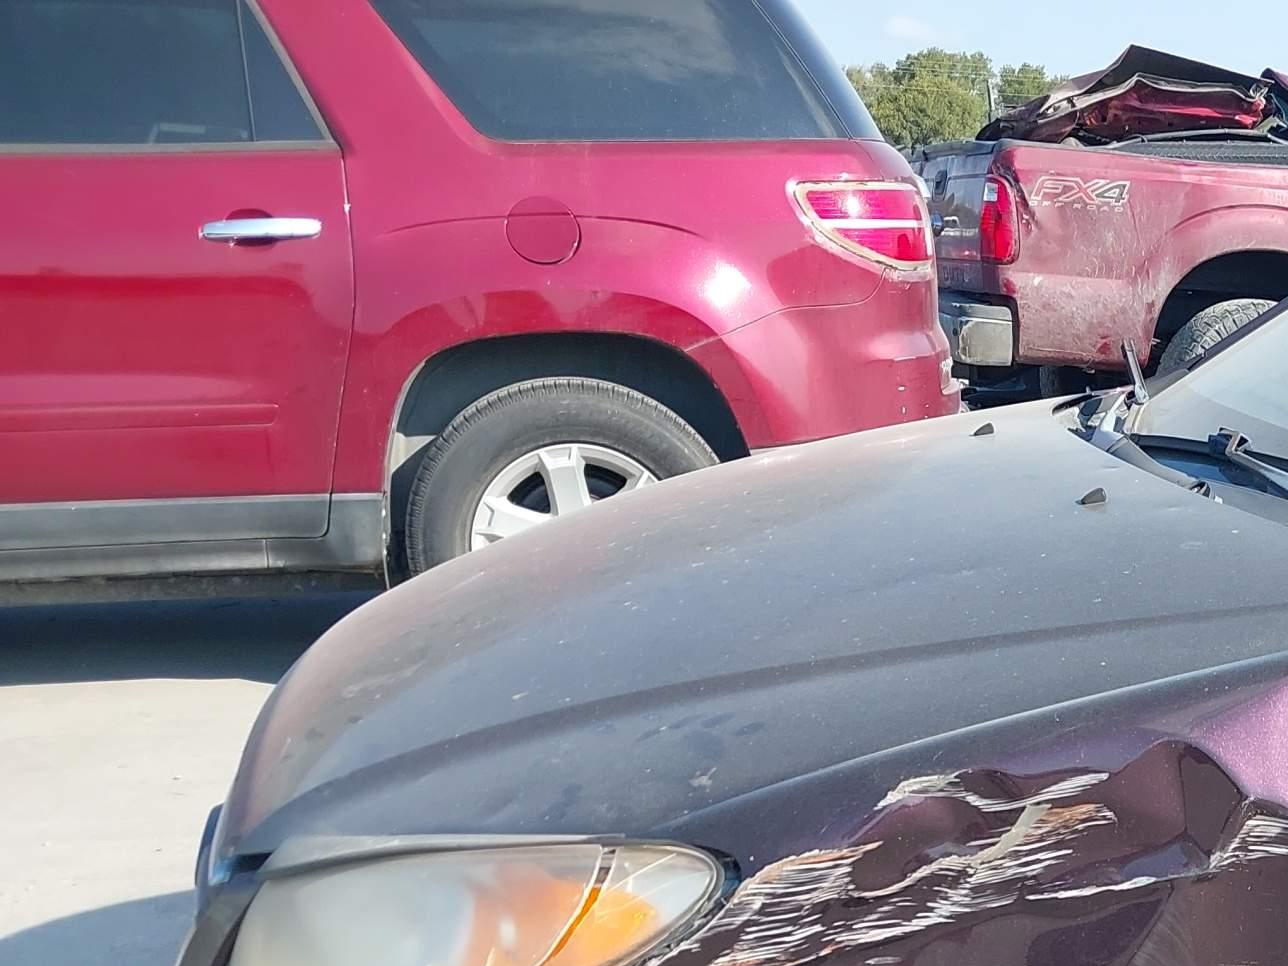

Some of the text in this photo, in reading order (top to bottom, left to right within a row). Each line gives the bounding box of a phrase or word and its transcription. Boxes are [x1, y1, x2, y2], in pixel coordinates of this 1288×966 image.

[1030, 176, 1131, 206] FX4
[1028, 199, 1125, 213] OFF ROAD
